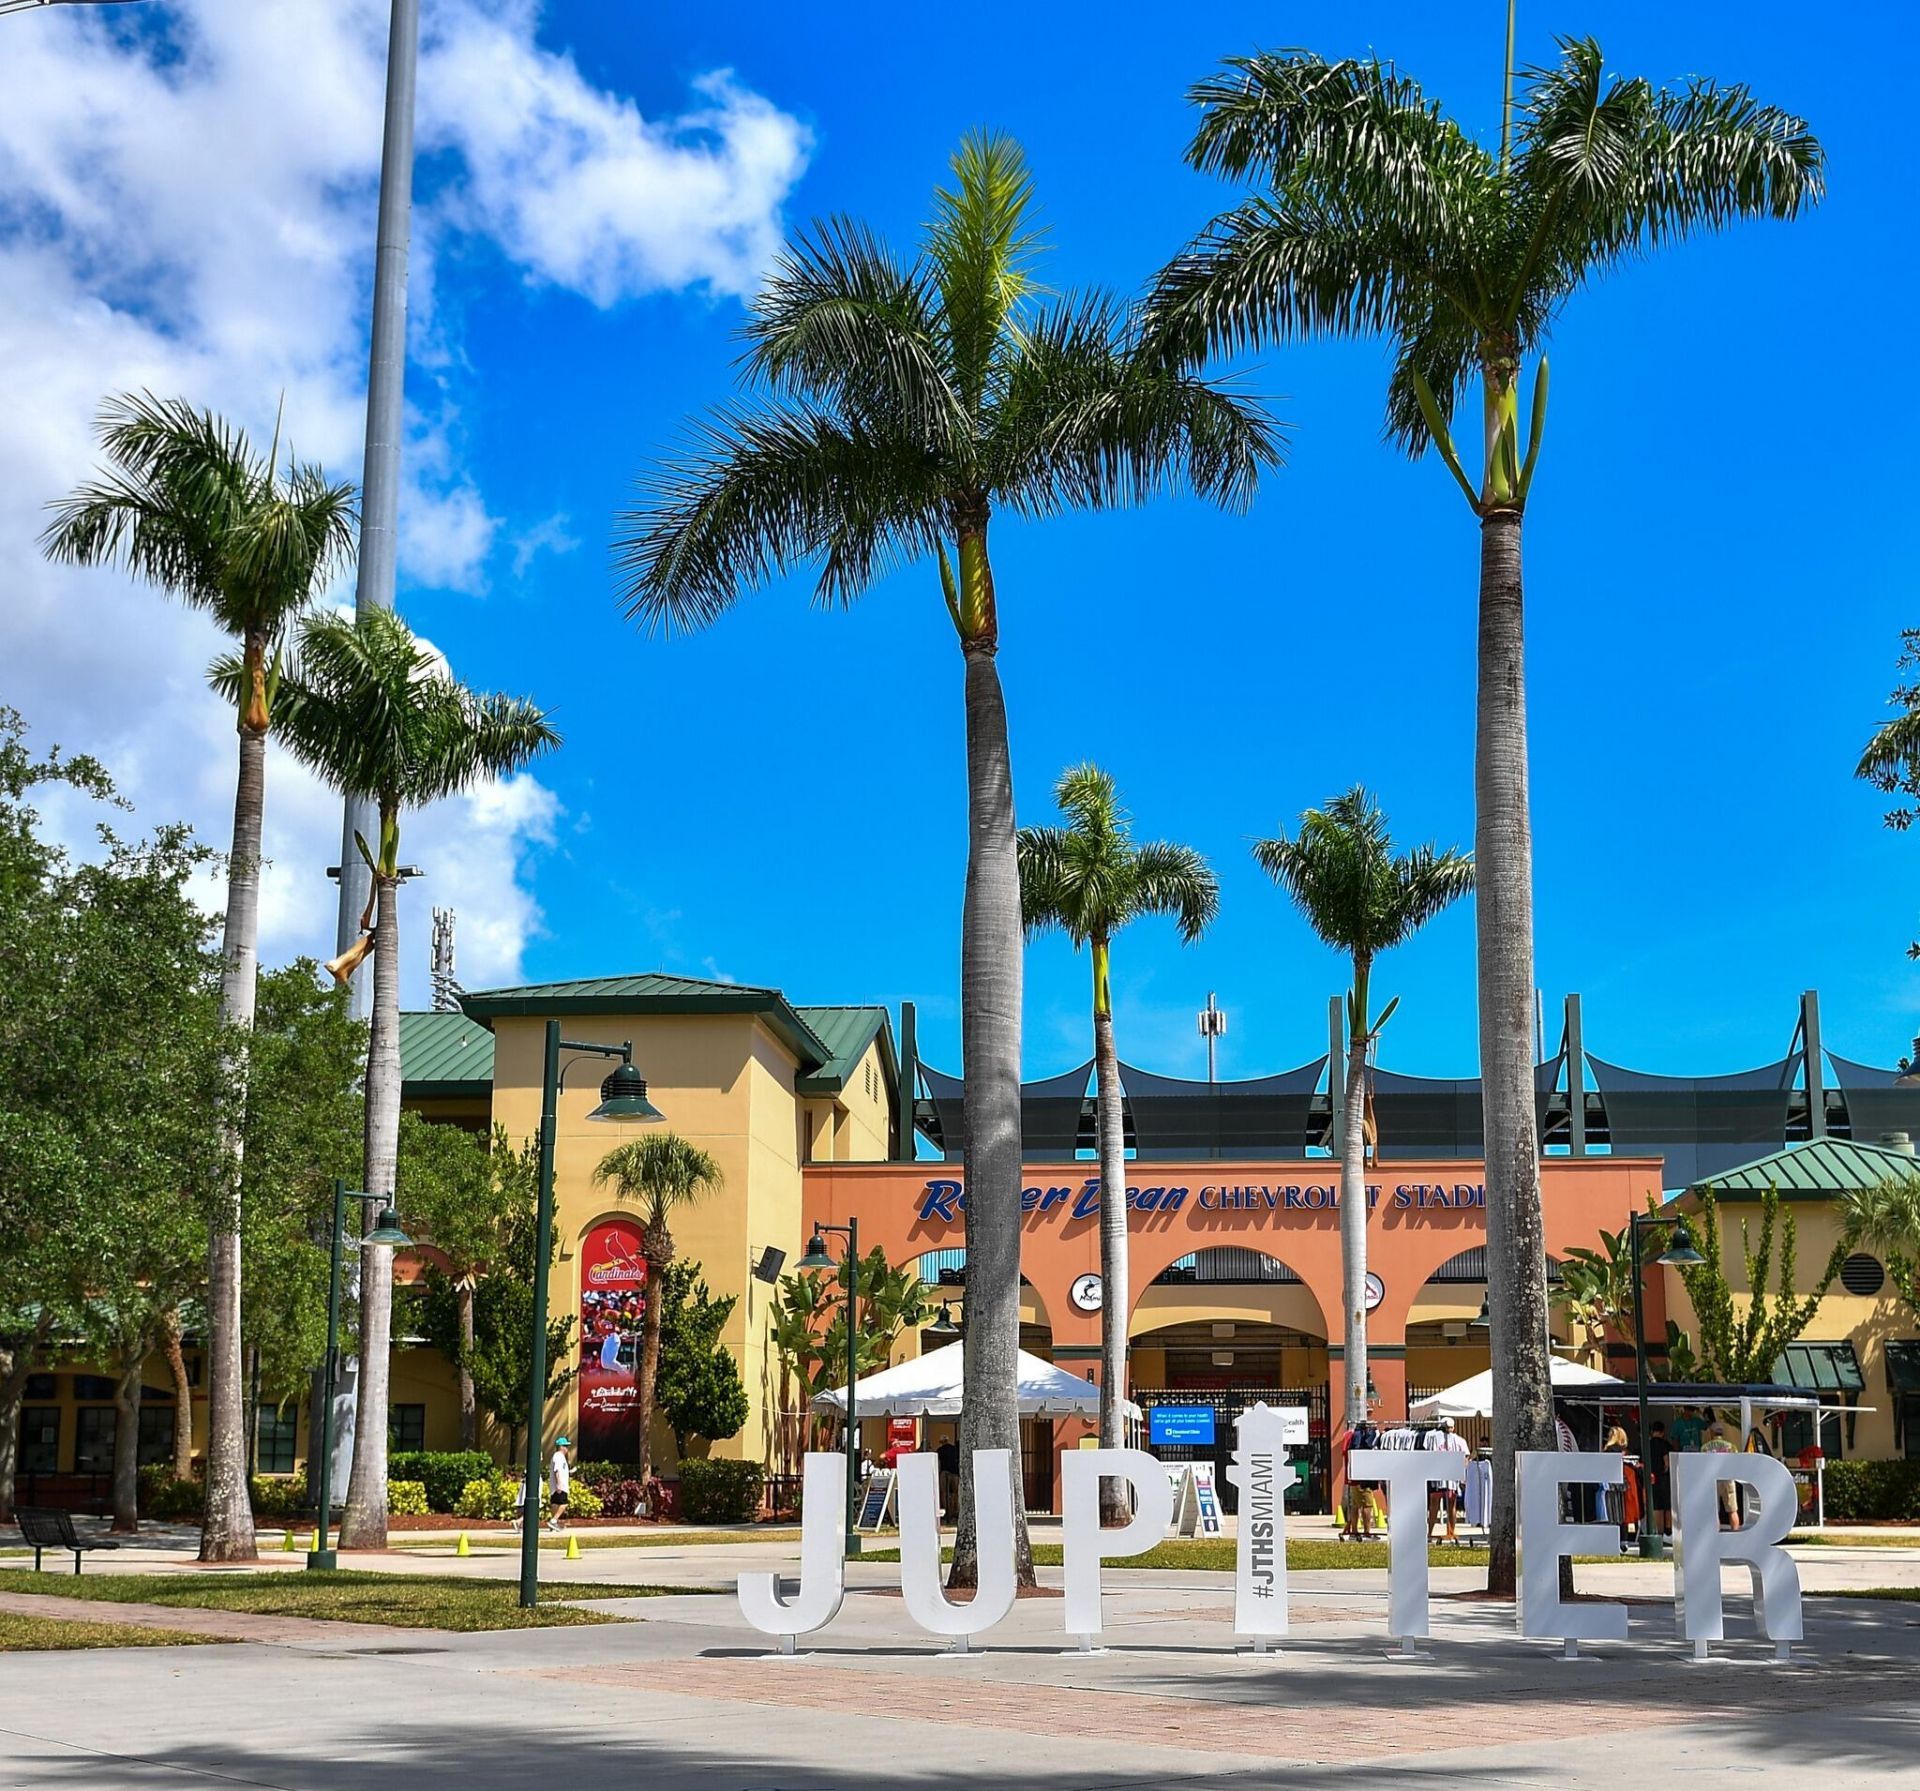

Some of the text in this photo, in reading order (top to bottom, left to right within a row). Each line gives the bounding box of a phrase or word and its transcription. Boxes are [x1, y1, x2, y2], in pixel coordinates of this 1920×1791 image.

[918, 1179, 1072, 1222] Rer
[1198, 1184, 1383, 1210] CHEVROLT
[1394, 1183, 1486, 1210] STADI
[588, 1263, 644, 1284] Cardinals
[738, 1401, 1805, 1640] JUPITER
[1251, 1453, 1274, 1599] #JTHSMIAMI
